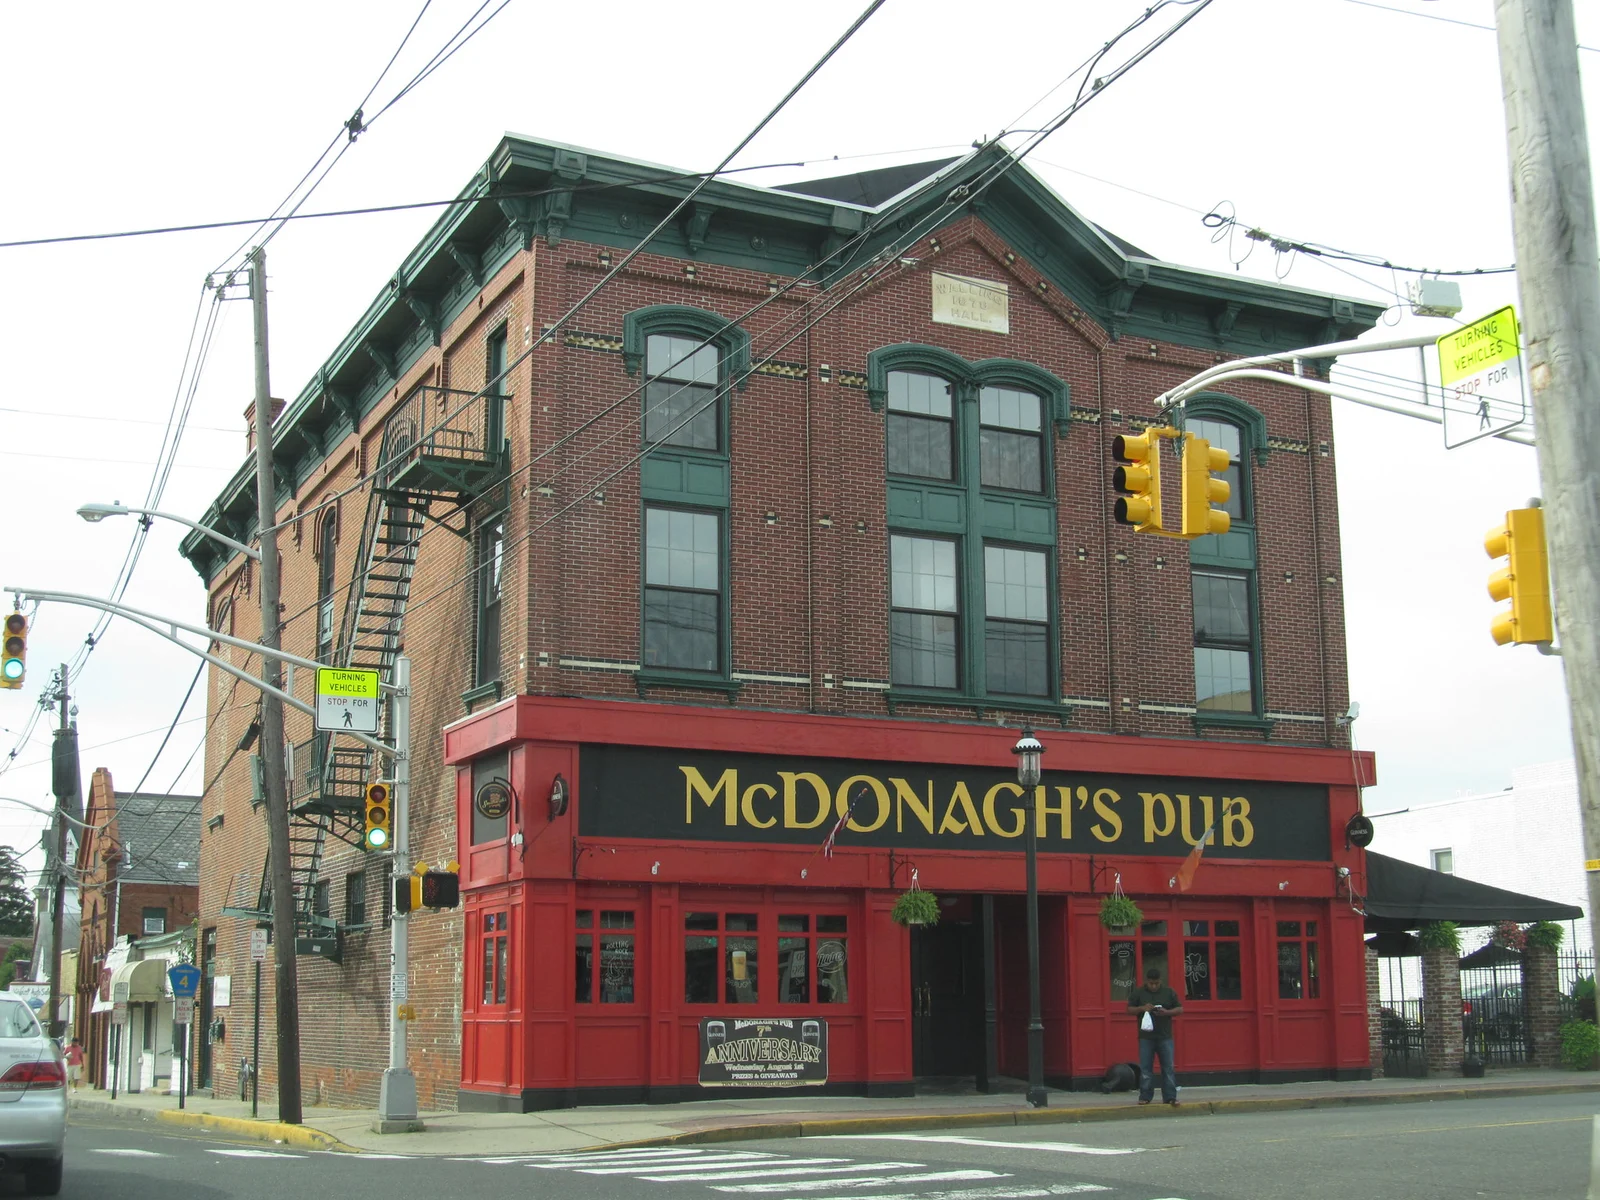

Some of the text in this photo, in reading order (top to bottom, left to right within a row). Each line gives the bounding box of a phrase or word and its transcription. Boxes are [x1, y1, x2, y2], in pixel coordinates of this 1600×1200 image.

[1454, 320, 1498, 350] TURNING
[1454, 340, 1504, 371] VEHICLES
[1455, 367, 1509, 400] STOP FOR
[332, 672, 366, 682] TURNING
[329, 683, 367, 693] VEHICLES
[327, 697, 368, 707] STOP FOR
[1138, 790, 1255, 848] PUB
[1109, 942, 1135, 955] GUINNES
[179, 976, 189, 988] 4
[780, 1019, 794, 1029] PUB
[756, 1026, 772, 1038] 7th
[705, 1038, 822, 1065] ANNIVERSARY
[767, 1063, 792, 1072] August
